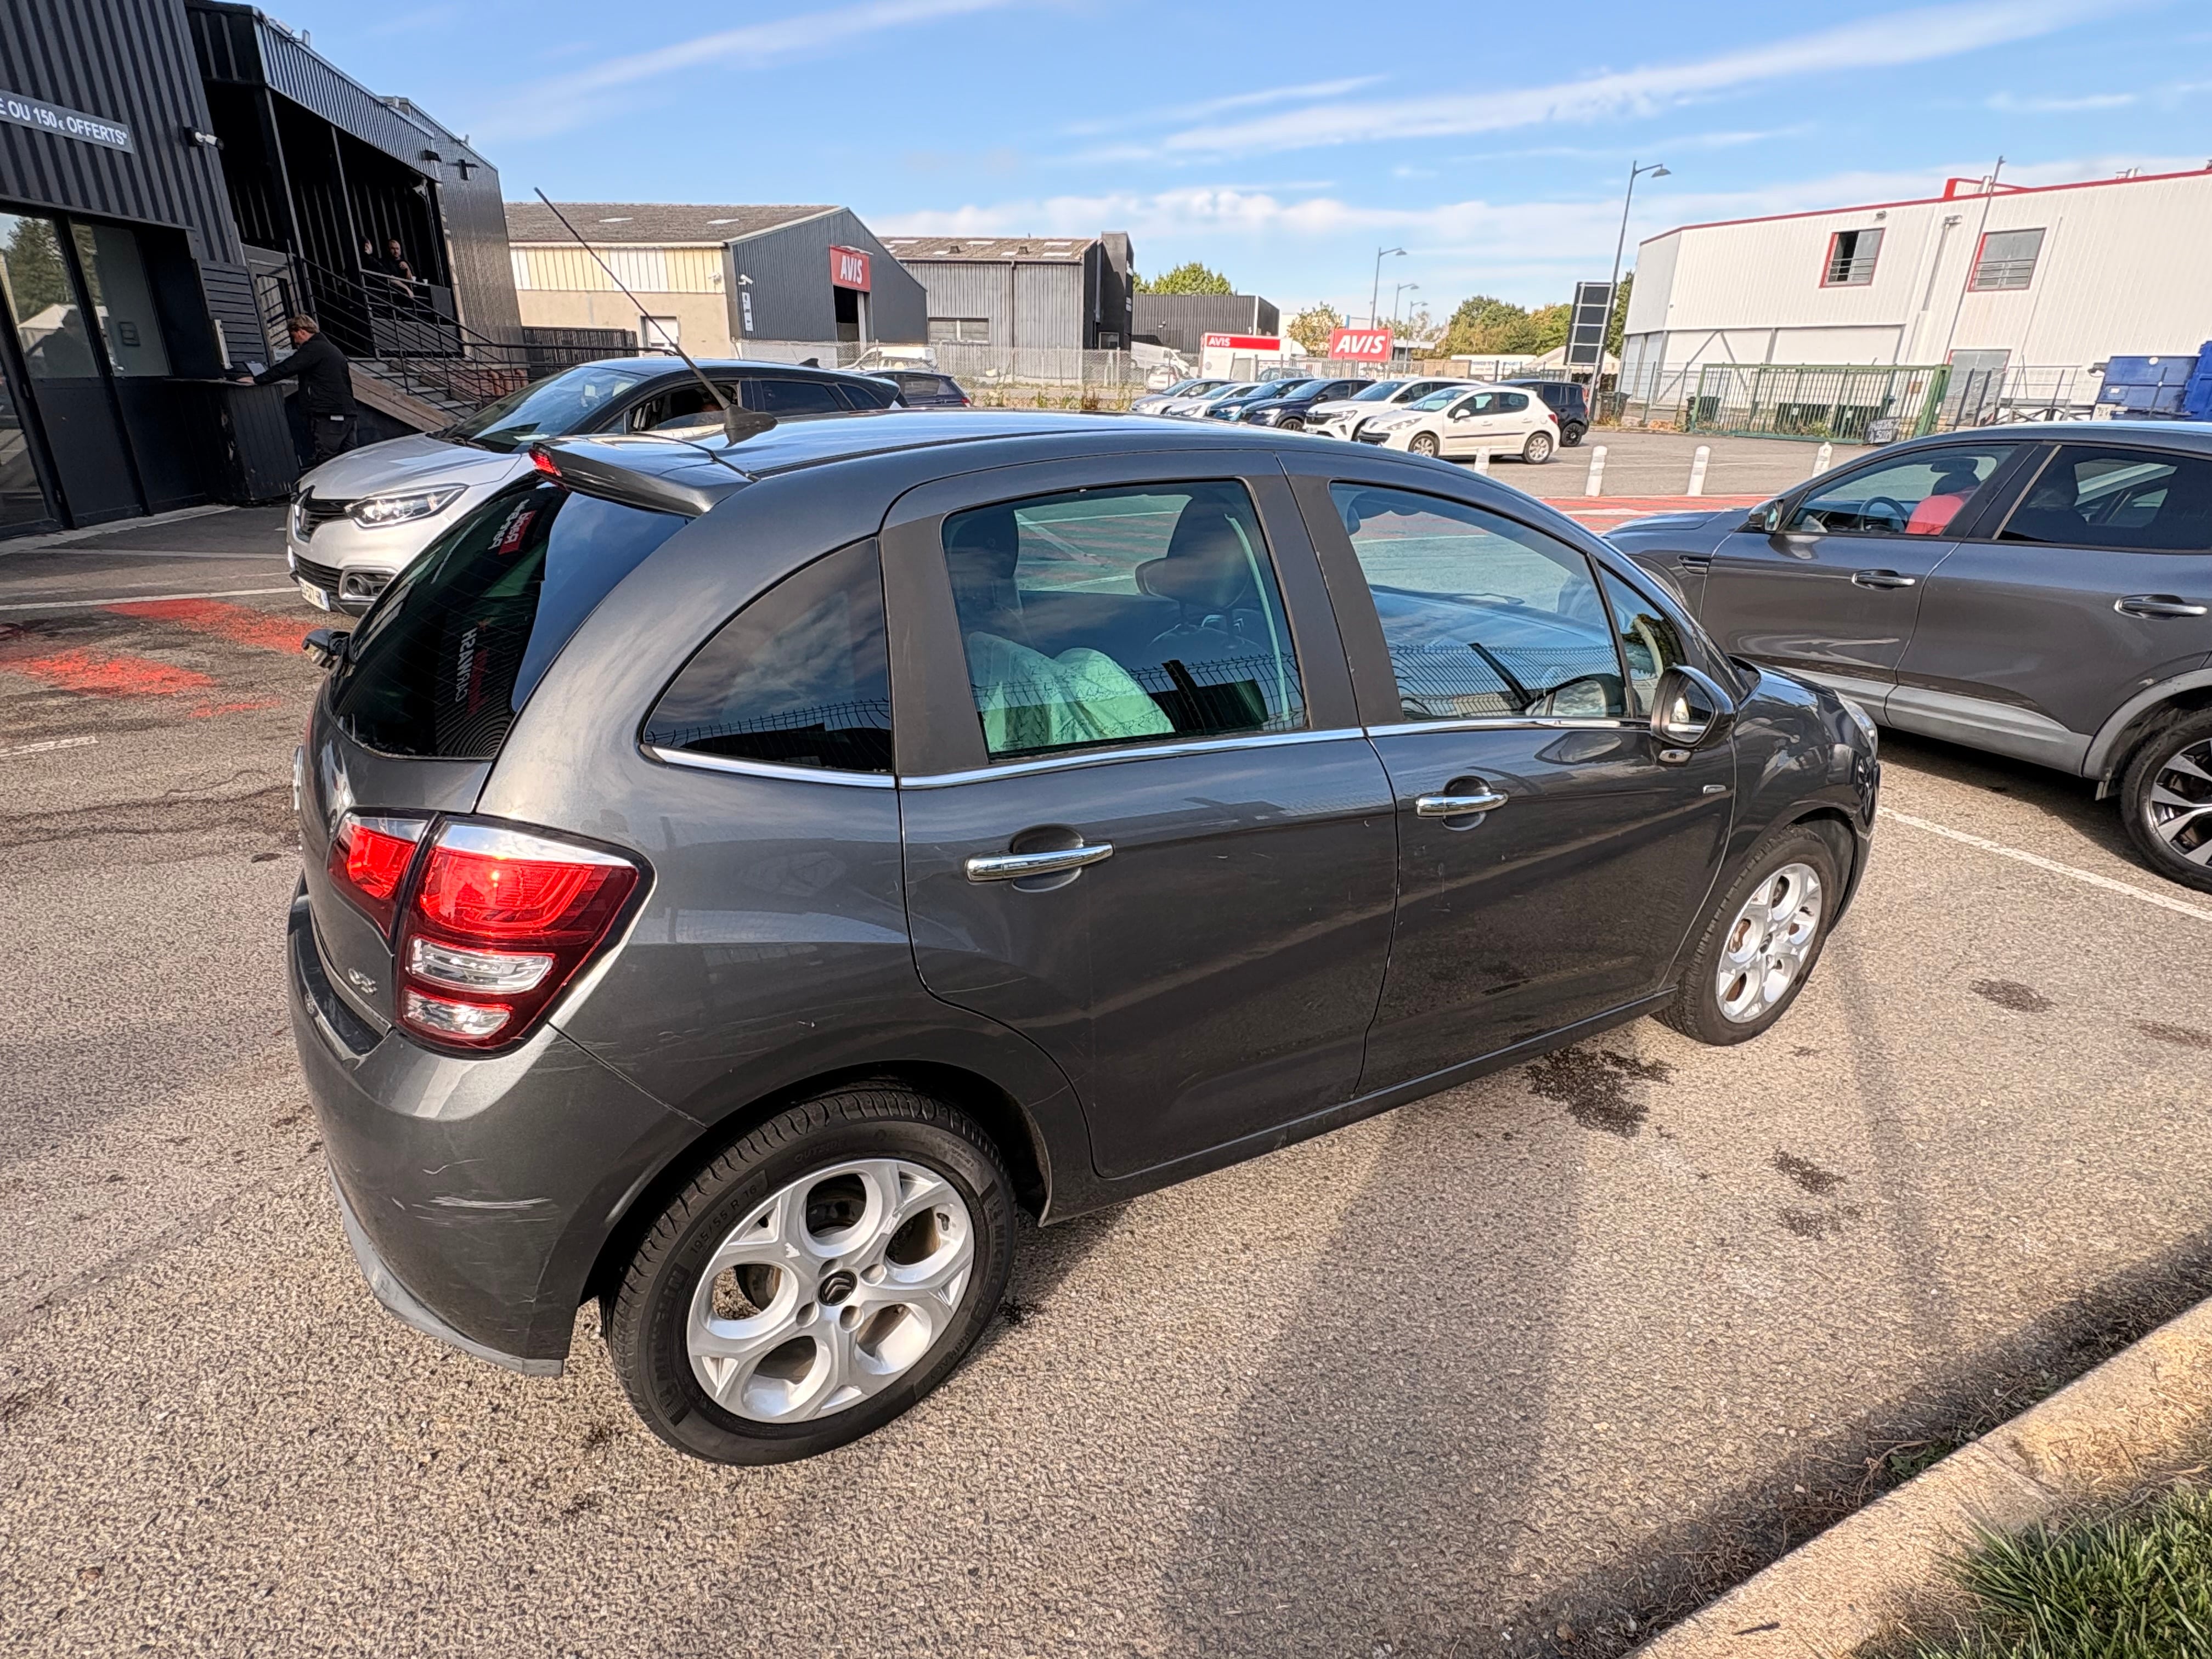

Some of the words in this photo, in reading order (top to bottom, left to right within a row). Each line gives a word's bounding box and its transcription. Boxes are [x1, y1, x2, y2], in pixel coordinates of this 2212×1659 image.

[8, 100, 31, 121] OU
[33, 107, 65, 131] 150€
[840, 255, 862, 285] AVIS
[1208, 337, 1231, 347] AVIS
[1334, 335, 1386, 354] AVIS
[690, 1209, 728, 1254] 195/55
[730, 1198, 740, 1211] R
[742, 1184, 757, 1198] 16
[930, 1331, 970, 1383] PRIMACY
